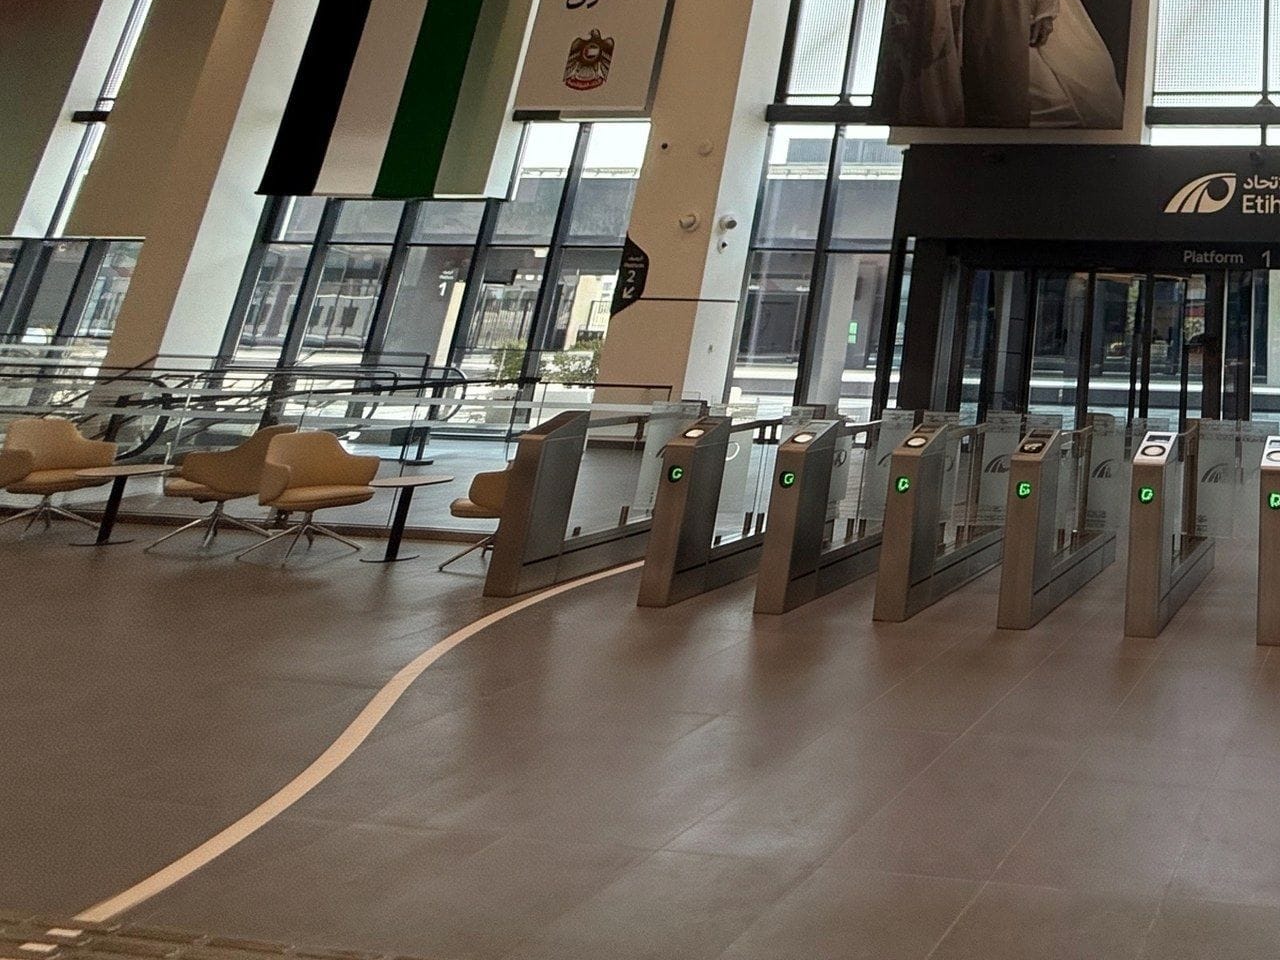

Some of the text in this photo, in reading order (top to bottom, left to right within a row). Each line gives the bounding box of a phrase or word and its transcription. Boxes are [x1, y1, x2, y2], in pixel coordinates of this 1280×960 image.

[1183, 250, 1271, 268] Platform 1
[626, 270, 636, 283] 2
[438, 281, 447, 297] 1
